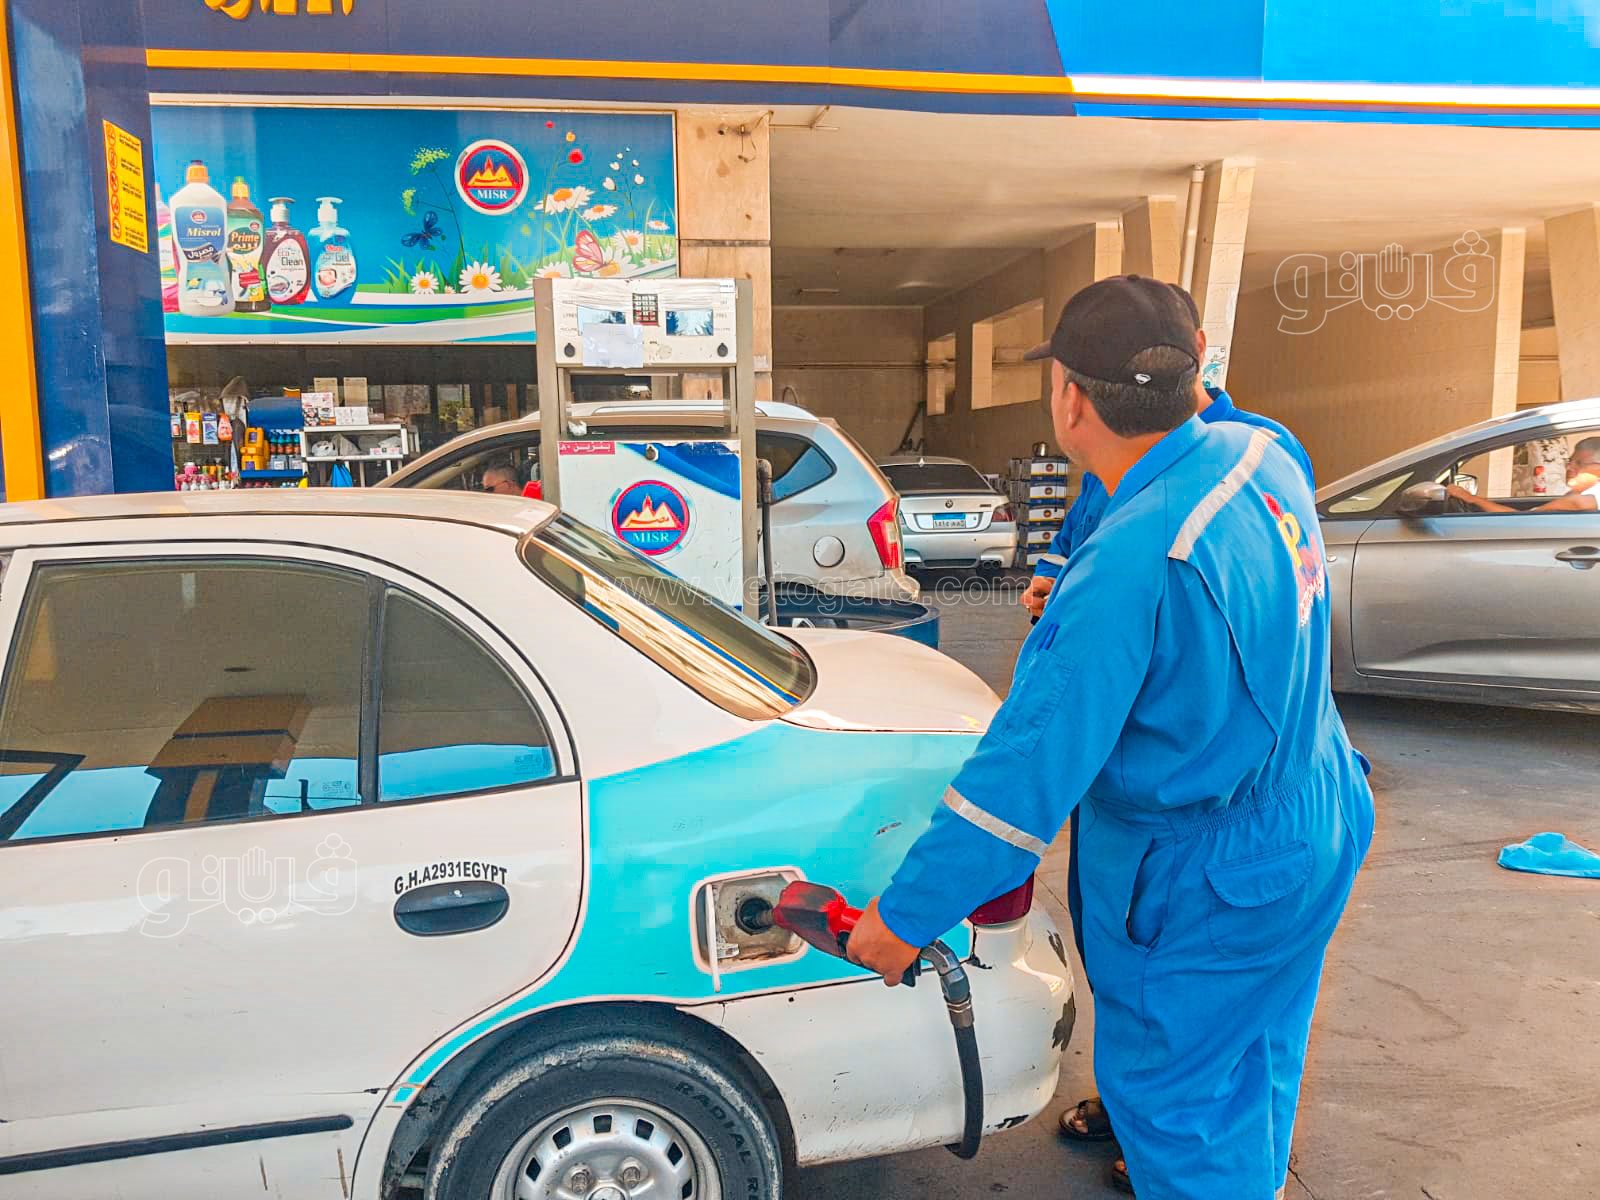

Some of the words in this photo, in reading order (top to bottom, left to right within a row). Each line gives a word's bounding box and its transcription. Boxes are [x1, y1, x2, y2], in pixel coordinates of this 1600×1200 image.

[477, 189, 508, 199] MISR
[187, 227, 221, 237] Misrol
[231, 232, 260, 243] Prime
[281, 257, 304, 266] Clean
[573, 441, 611, 453] بنزين
[632, 532, 670, 543] MISR
[394, 861, 507, 895] G.H.A2931EGYPT
[674, 1082, 751, 1163] RADIAL
